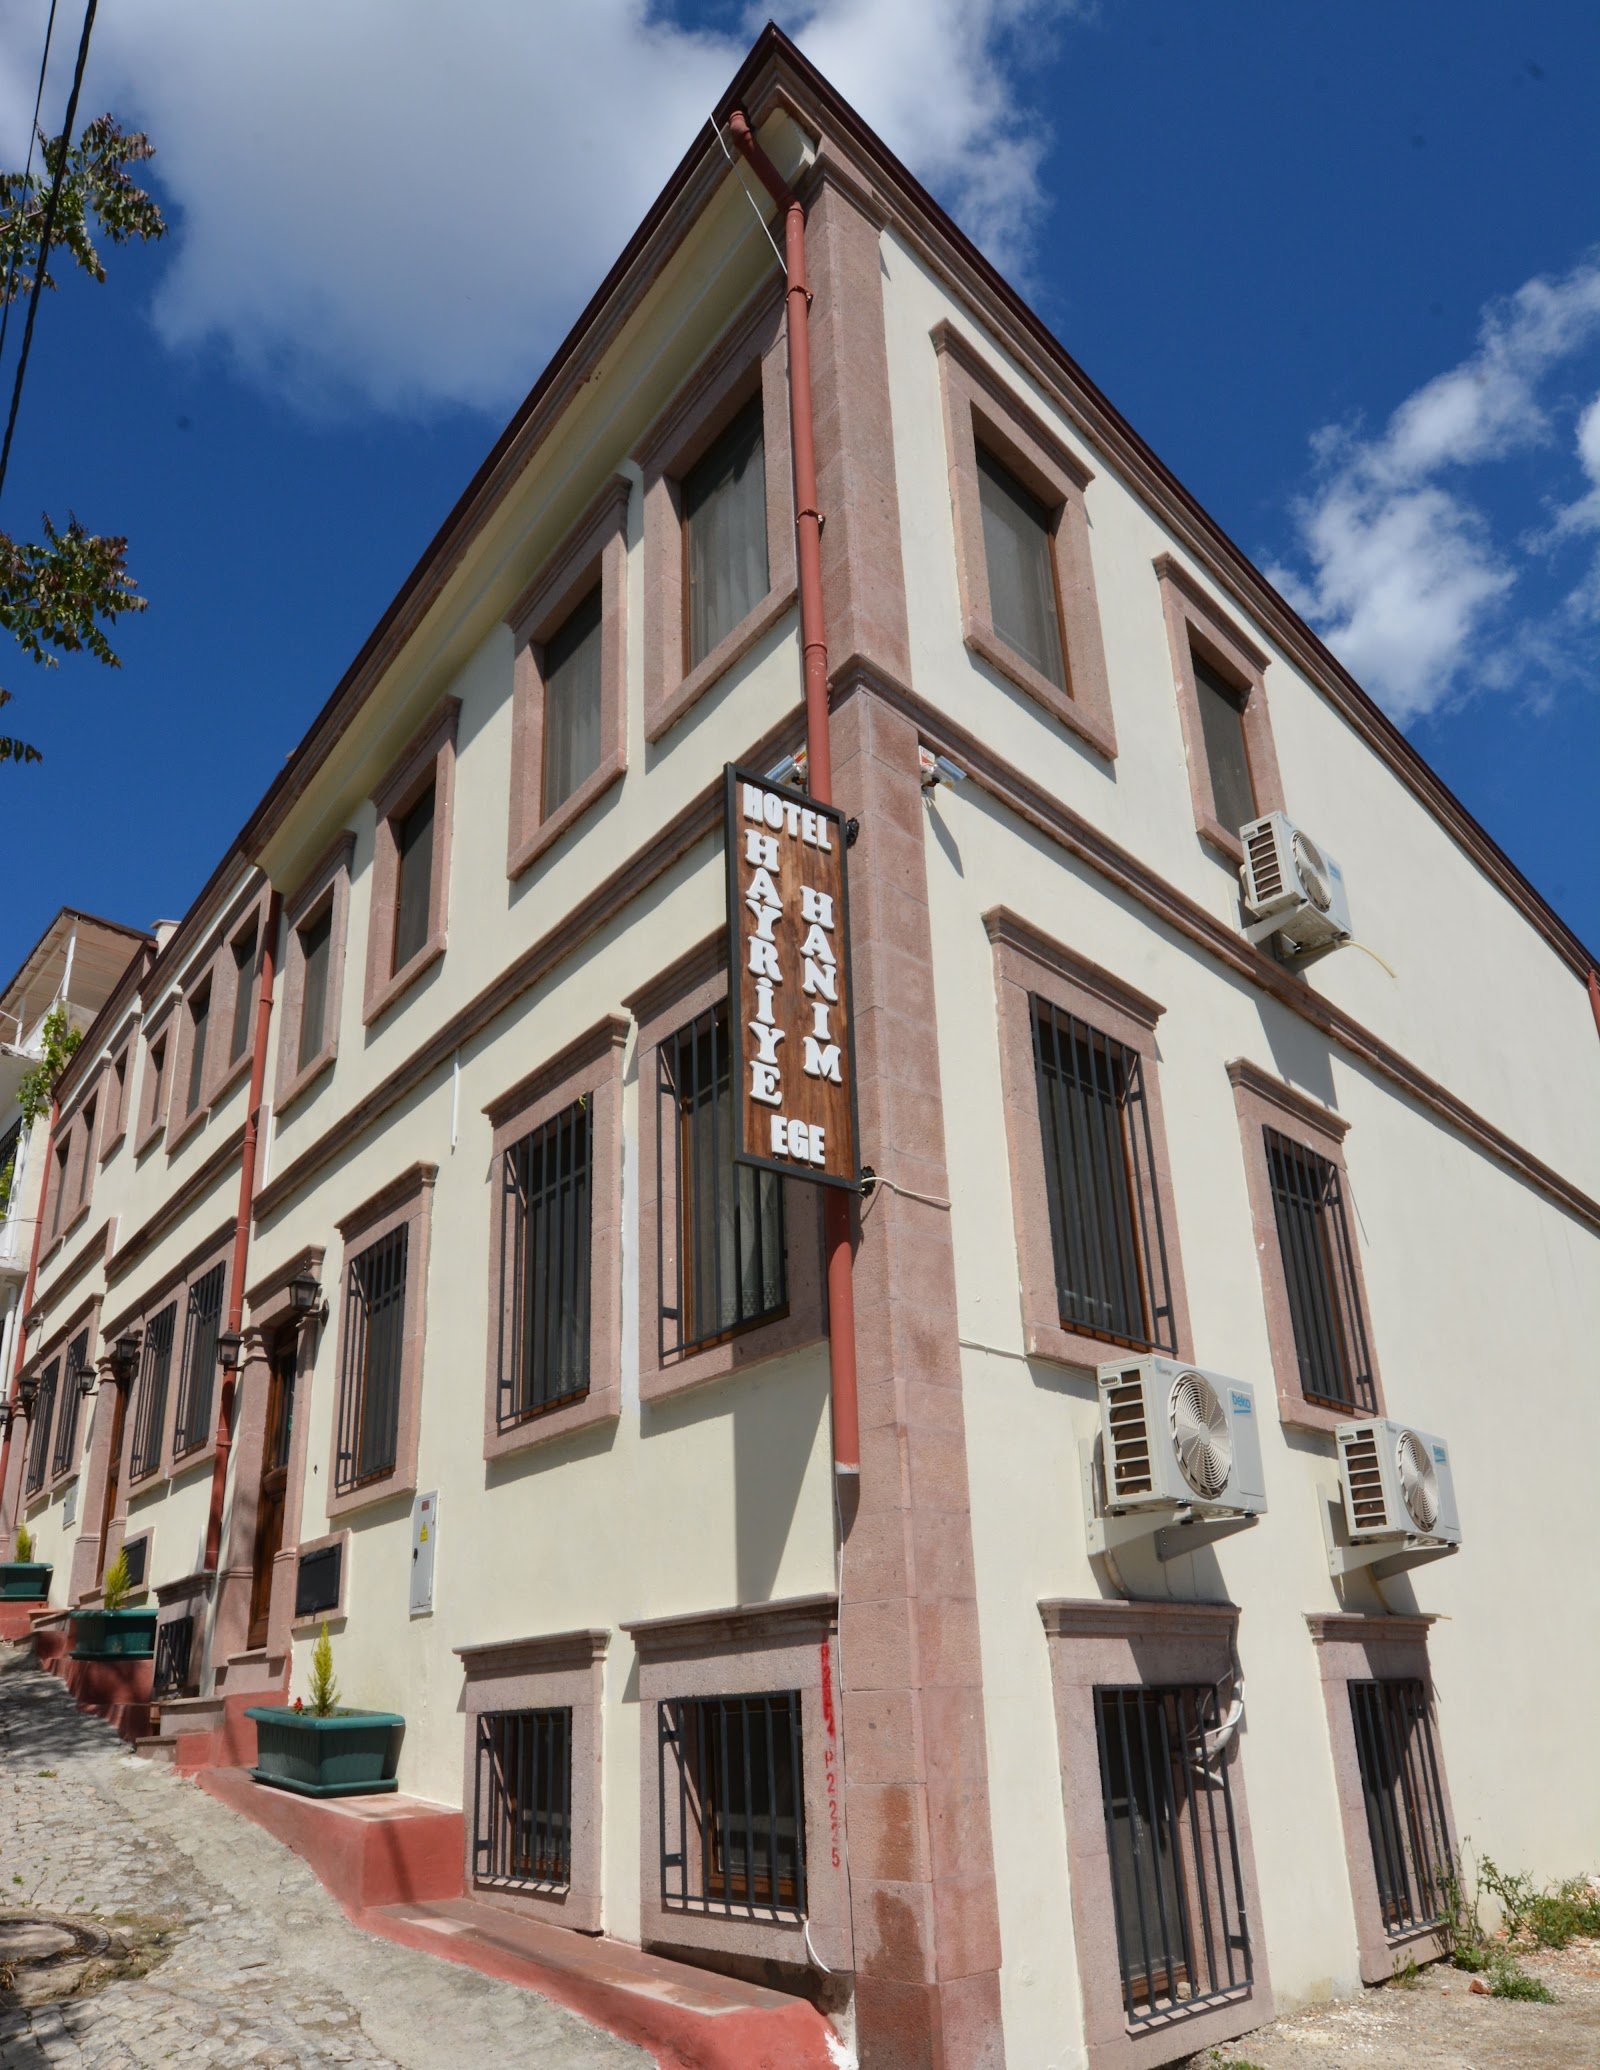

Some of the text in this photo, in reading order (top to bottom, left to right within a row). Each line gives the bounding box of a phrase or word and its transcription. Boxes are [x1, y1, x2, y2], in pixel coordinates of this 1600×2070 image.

[743, 783, 832, 851] HOTEL
[800, 886, 843, 1083] HANIM
[770, 1114, 826, 1165] EGE
